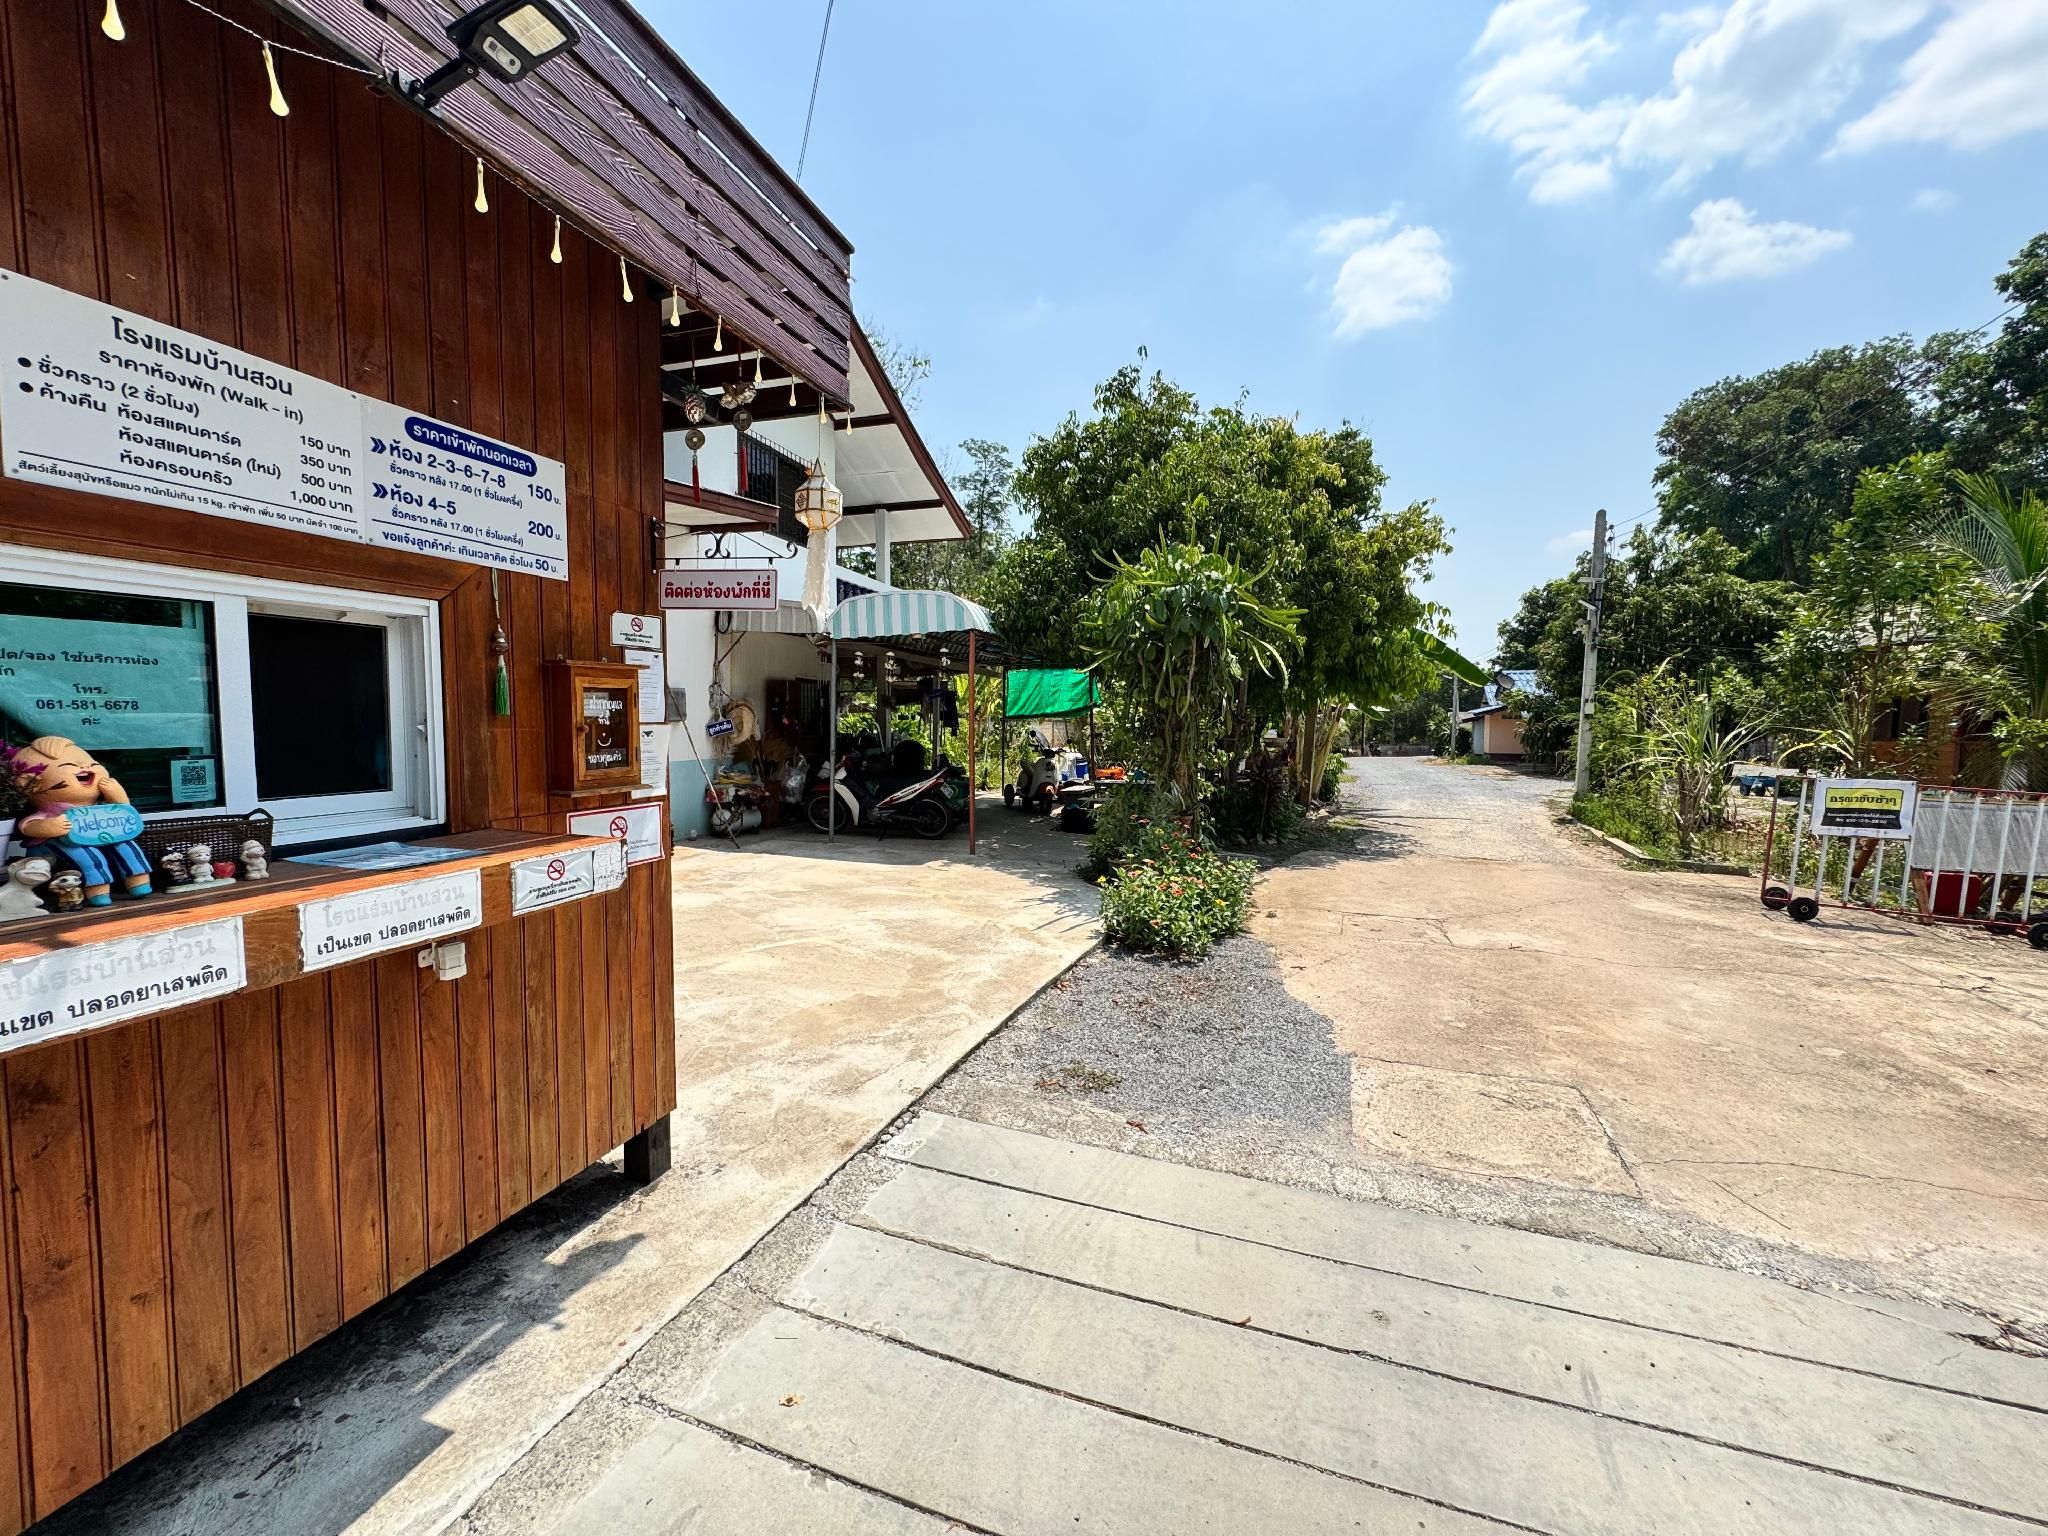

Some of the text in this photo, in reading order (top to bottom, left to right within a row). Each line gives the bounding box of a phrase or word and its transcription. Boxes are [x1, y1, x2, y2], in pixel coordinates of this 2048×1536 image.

[111, 316, 293, 395] โรงแรมบ้านสวน
[39, 355, 351, 458] ชั่วคราว (2 ชั่วโมง) 150 บาท
[99, 350, 214, 394] ราคาห้องพัก
[221, 386, 268, 412] (Walk
[284, 403, 303, 424] in)
[39, 382, 351, 476] ค้างคืน ห้องสแตนดาร์ด 350 บาท
[414, 424, 532, 471] ราคาเข้าพักนอกเวลา
[119, 427, 352, 495] ห้องสแตนดาร์ด (ใหม่) 500 บาท
[120, 450, 353, 514] ห้องครอบครัว 1,000 บาท
[389, 439, 422, 465] ห้อง
[527, 483, 552, 502] 150
[554, 496, 561, 505] บ.
[390, 460, 523, 509] ชั่วคราว หลัง 17.00 (1 ชั่วโมงครึ่ง)
[19, 460, 141, 492] สัตว์เลี้ยงสุนัขหรือแมว
[211, 500, 226, 509] kg.
[229, 501, 255, 514] เข้าพัก
[259, 506, 274, 518] เพิ่ม
[289, 516, 304, 524] บาท
[307, 518, 327, 528] มัดจำ
[329, 523, 342, 532] 100
[344, 527, 358, 535] บาท
[390, 484, 423, 507] ห้อง
[528, 521, 553, 538] 200
[555, 532, 562, 541] บ.
[392, 506, 524, 547] ชั่วคราว หลัง 17.00 (1 ชั่วโมงครึ่ง)
[458, 544, 507, 563] เกินเวลาคิด
[509, 553, 533, 569] ชั่วโมง
[535, 558, 549, 571] 50
[551, 564, 559, 573] บ.
[664, 574, 771, 598] ติดต่อห้องพักที่นี่
[61, 650, 158, 666] ใช้บริการห้อง
[36, 700, 139, 711] 061-581-6678
[73, 684, 107, 694] โทร.
[82, 714, 101, 726] ค่ะ
[74, 813, 136, 834] Welcome
[322, 882, 465, 928] โรงแรมบ้านสวน
[317, 906, 471, 956] เป็นเขต ปลอดยาเสพติด
[67, 965, 227, 1020] ปลอดยาเสพติด
